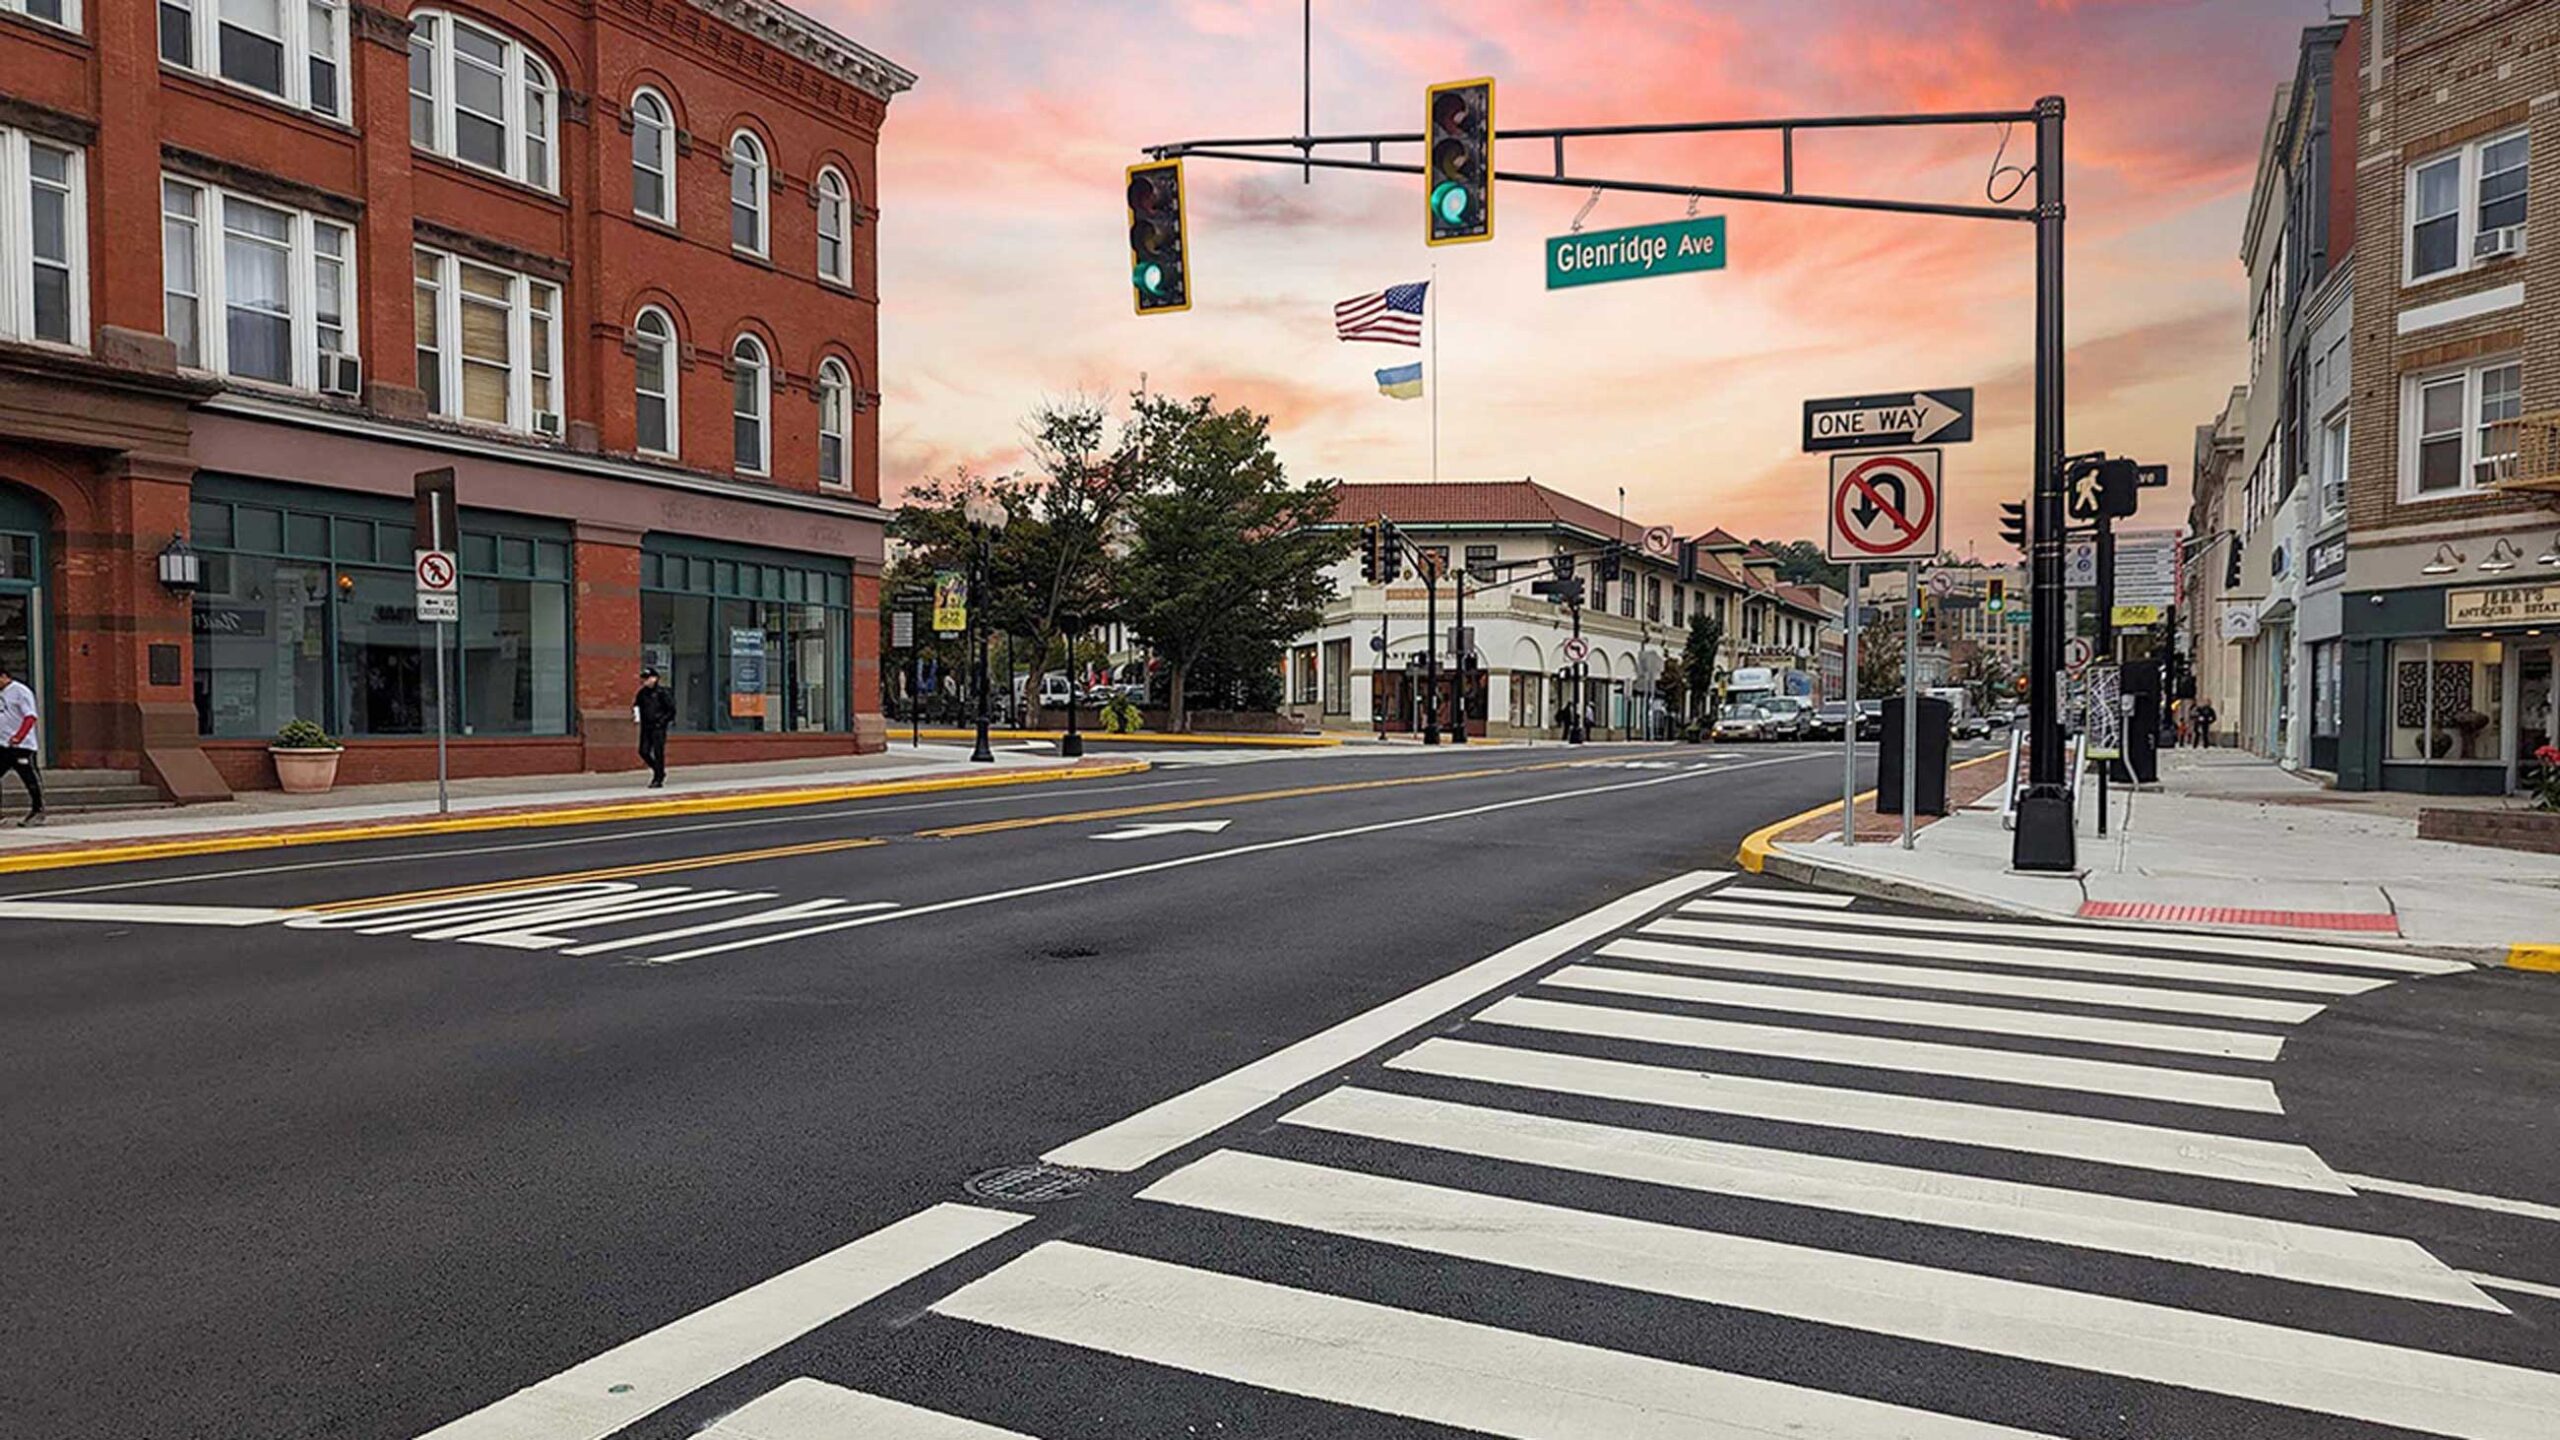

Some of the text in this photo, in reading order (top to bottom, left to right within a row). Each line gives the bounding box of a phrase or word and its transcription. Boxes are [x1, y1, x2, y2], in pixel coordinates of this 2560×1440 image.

[1557, 234, 1714, 271] Glenridge Ave
[1818, 407, 1929, 435] ONE WAY
[2482, 587, 2545, 608] JERRY'S
[2458, 605, 2513, 618] ANTIQUES
